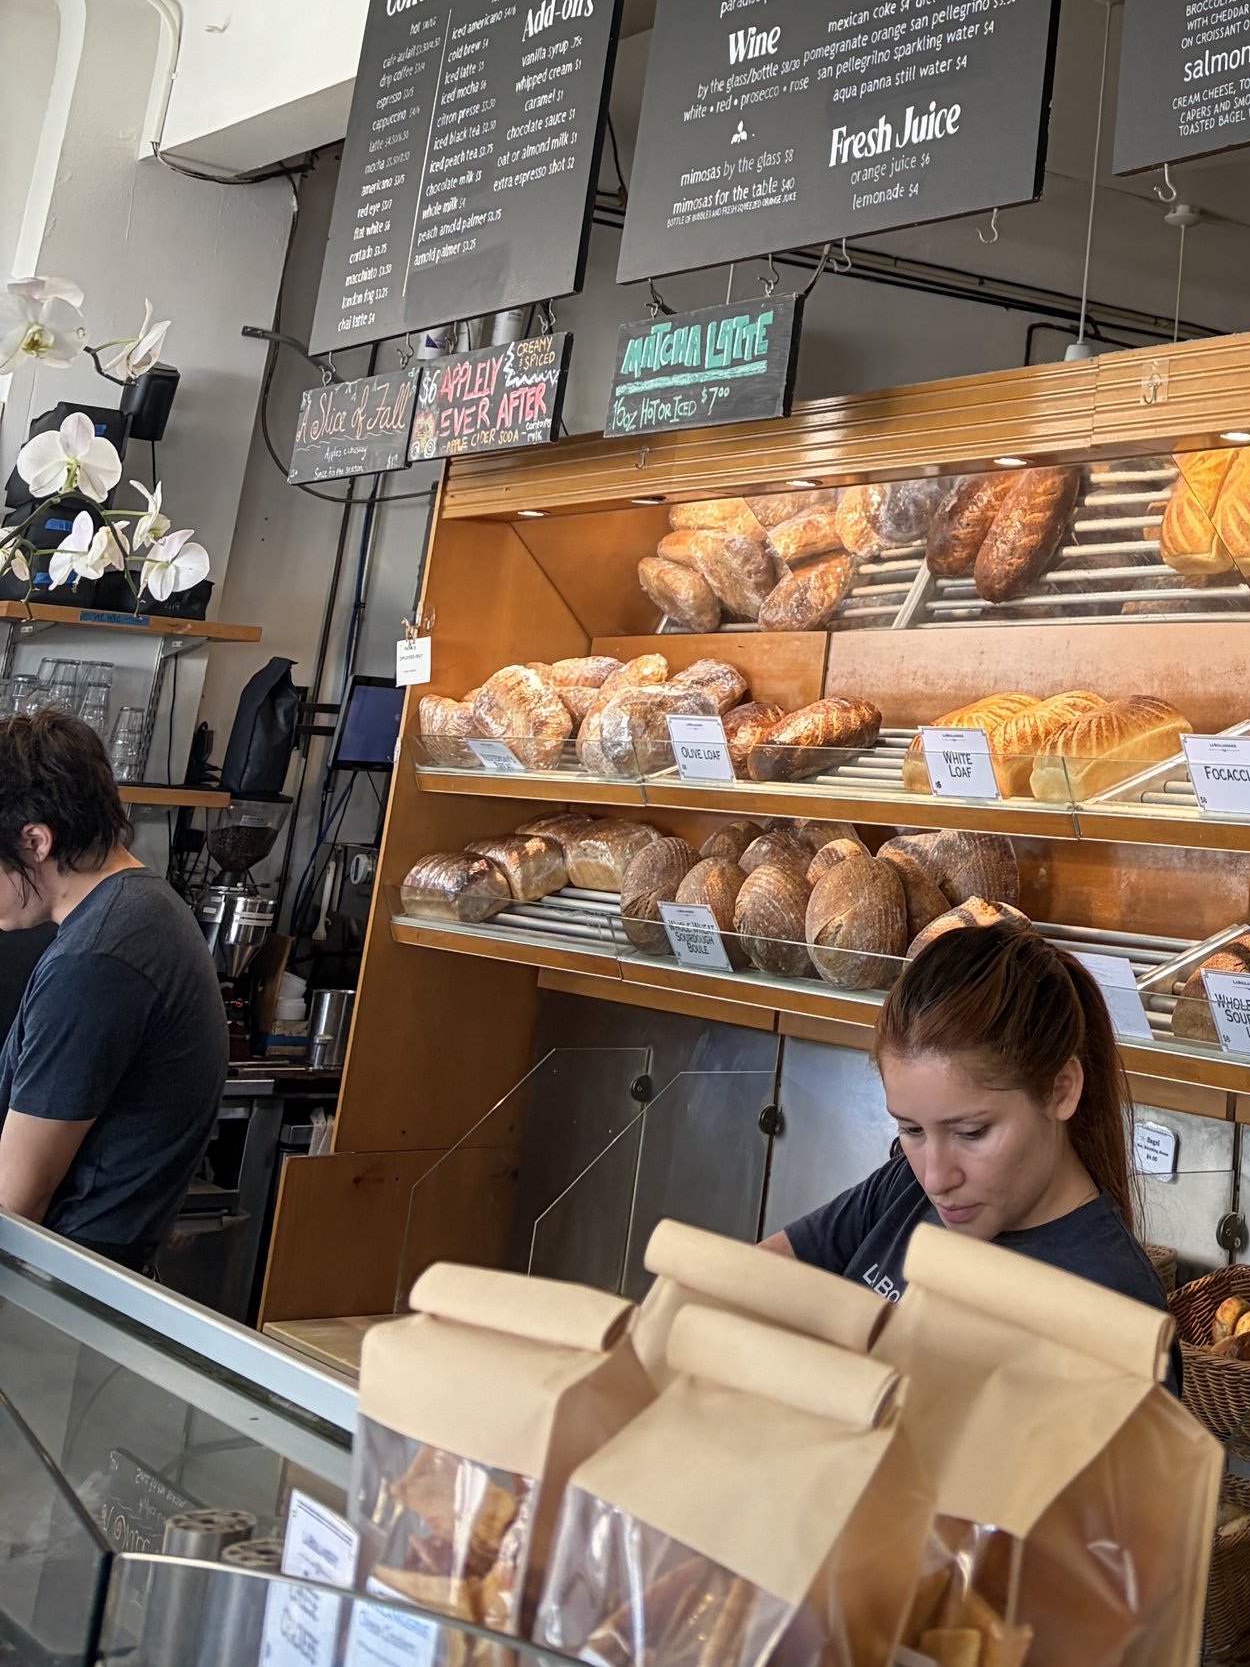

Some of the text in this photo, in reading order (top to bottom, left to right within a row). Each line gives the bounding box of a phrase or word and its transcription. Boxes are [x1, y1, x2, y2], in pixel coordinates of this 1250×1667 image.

[728, 25, 781, 65] Wine
[829, 100, 961, 167] Fresh Juice
[850, 160, 886, 185] orange
[889, 154, 917, 176] juice
[852, 184, 905, 210] lemonade
[517, 337, 553, 357] CREAMY
[621, 310, 774, 378] MATCHA LATTE
[419, 370, 441, 405] $6
[440, 383, 547, 437] EVER AFTER
[681, 746, 721, 761] OLIVE LOAF
[943, 750, 972, 765] WHITE
[949, 765, 971, 777] LOAF
[687, 943, 709, 954] BOULE
